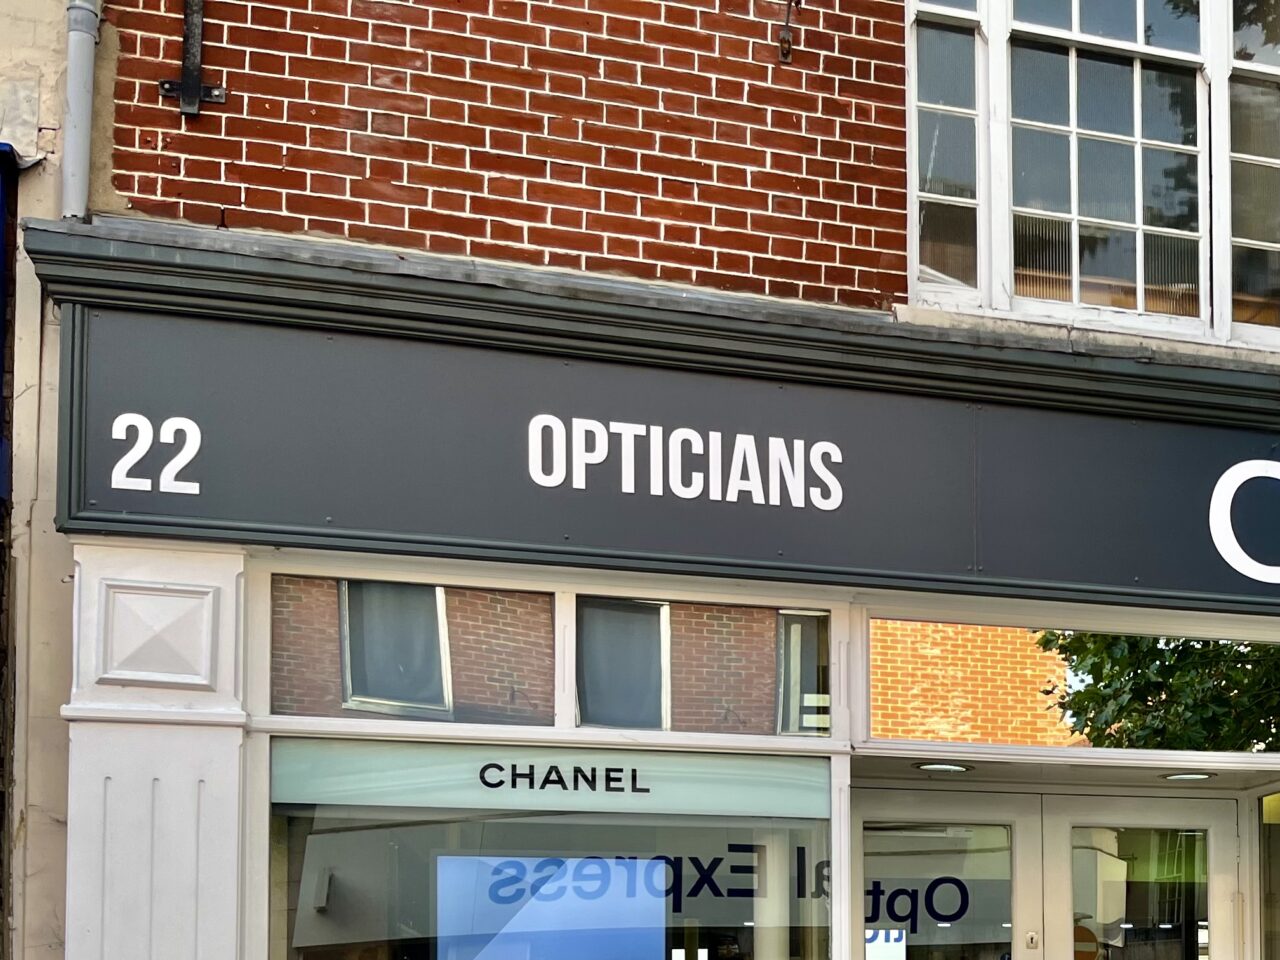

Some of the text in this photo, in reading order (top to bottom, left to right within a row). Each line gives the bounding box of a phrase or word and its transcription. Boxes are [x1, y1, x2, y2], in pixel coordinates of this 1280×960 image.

[110, 412, 203, 496] 22
[527, 413, 844, 512] OPTICIANS
[479, 762, 651, 794] CHANEL
